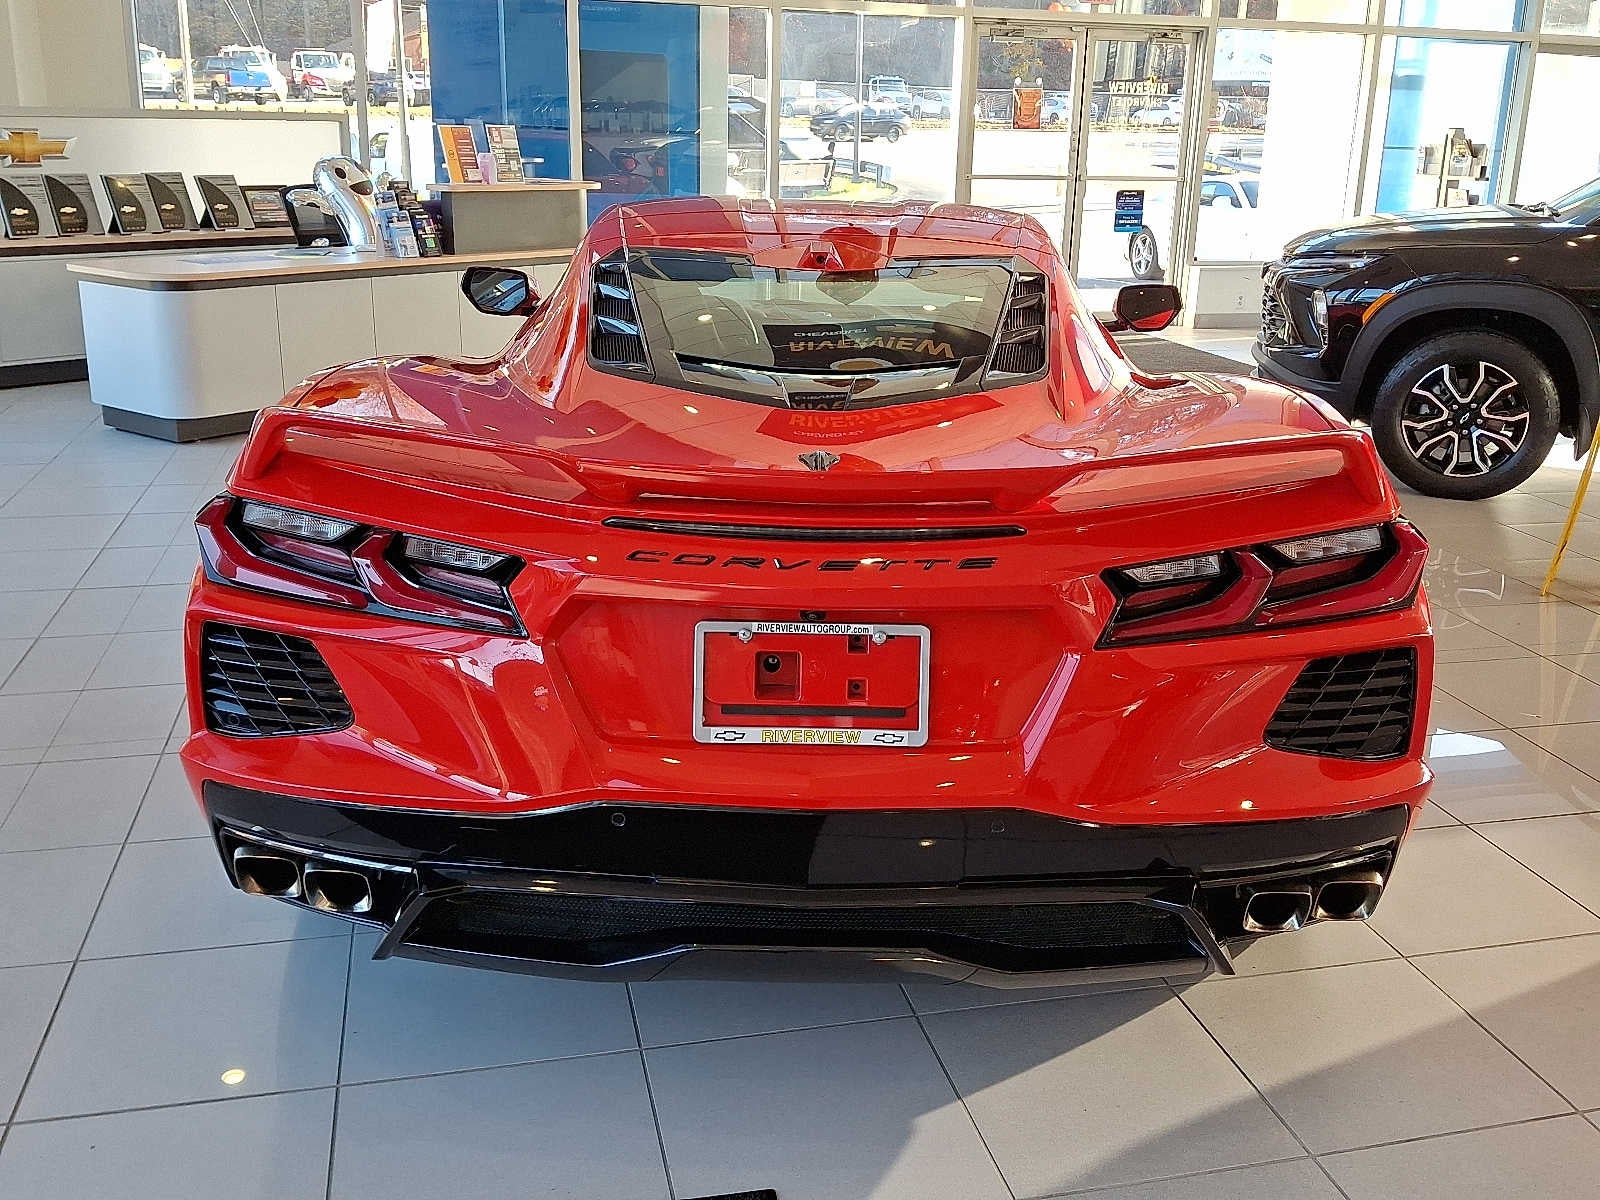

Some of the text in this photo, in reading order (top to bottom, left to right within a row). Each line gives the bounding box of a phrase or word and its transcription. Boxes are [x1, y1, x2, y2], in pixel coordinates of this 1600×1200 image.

[624, 549, 999, 572] CORVETTE
[756, 623, 870, 635] RIVERVIEWAUTOGROUP.com
[761, 729, 863, 743] RIVERVIEW
